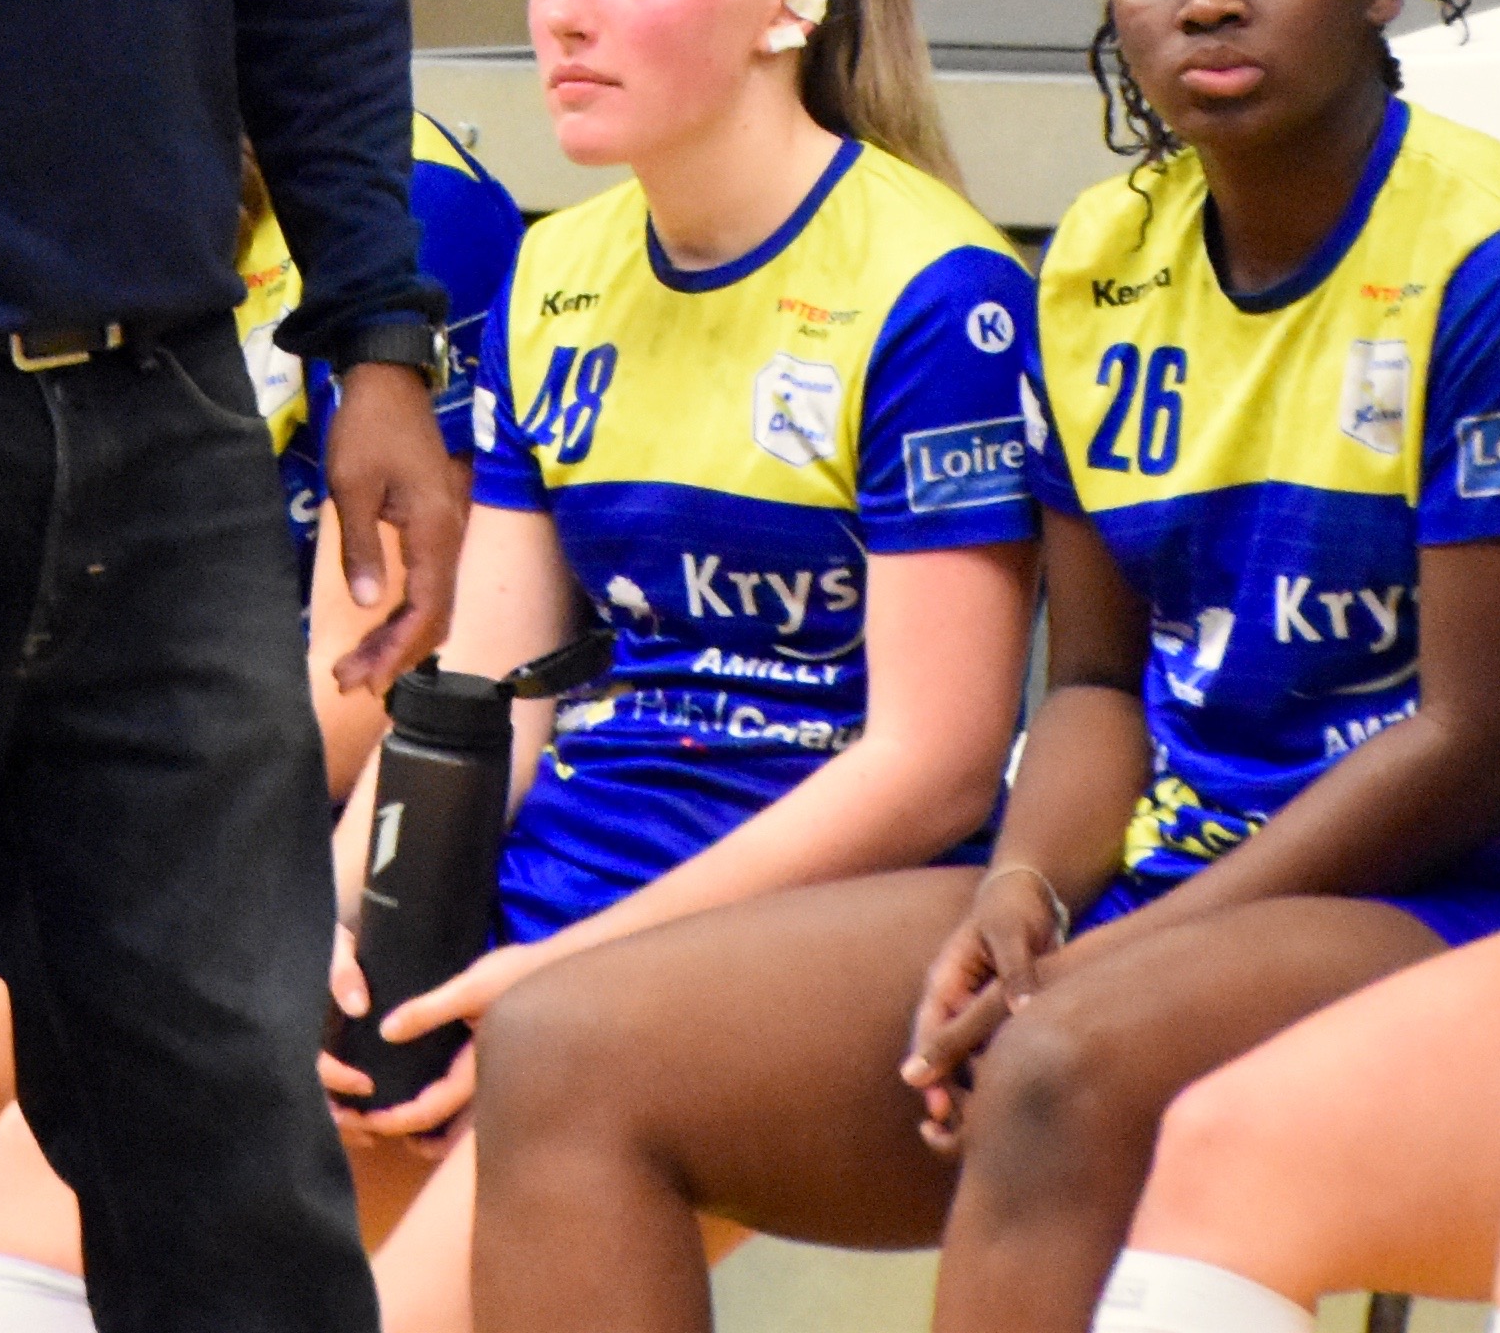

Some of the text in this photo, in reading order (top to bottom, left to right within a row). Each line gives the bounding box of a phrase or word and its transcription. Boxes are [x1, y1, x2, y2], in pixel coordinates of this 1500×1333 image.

[1086, 342, 1188, 477] 26
[919, 437, 1025, 483] Loire
[681, 552, 860, 635] Krys
[1274, 574, 1412, 654] Kry
